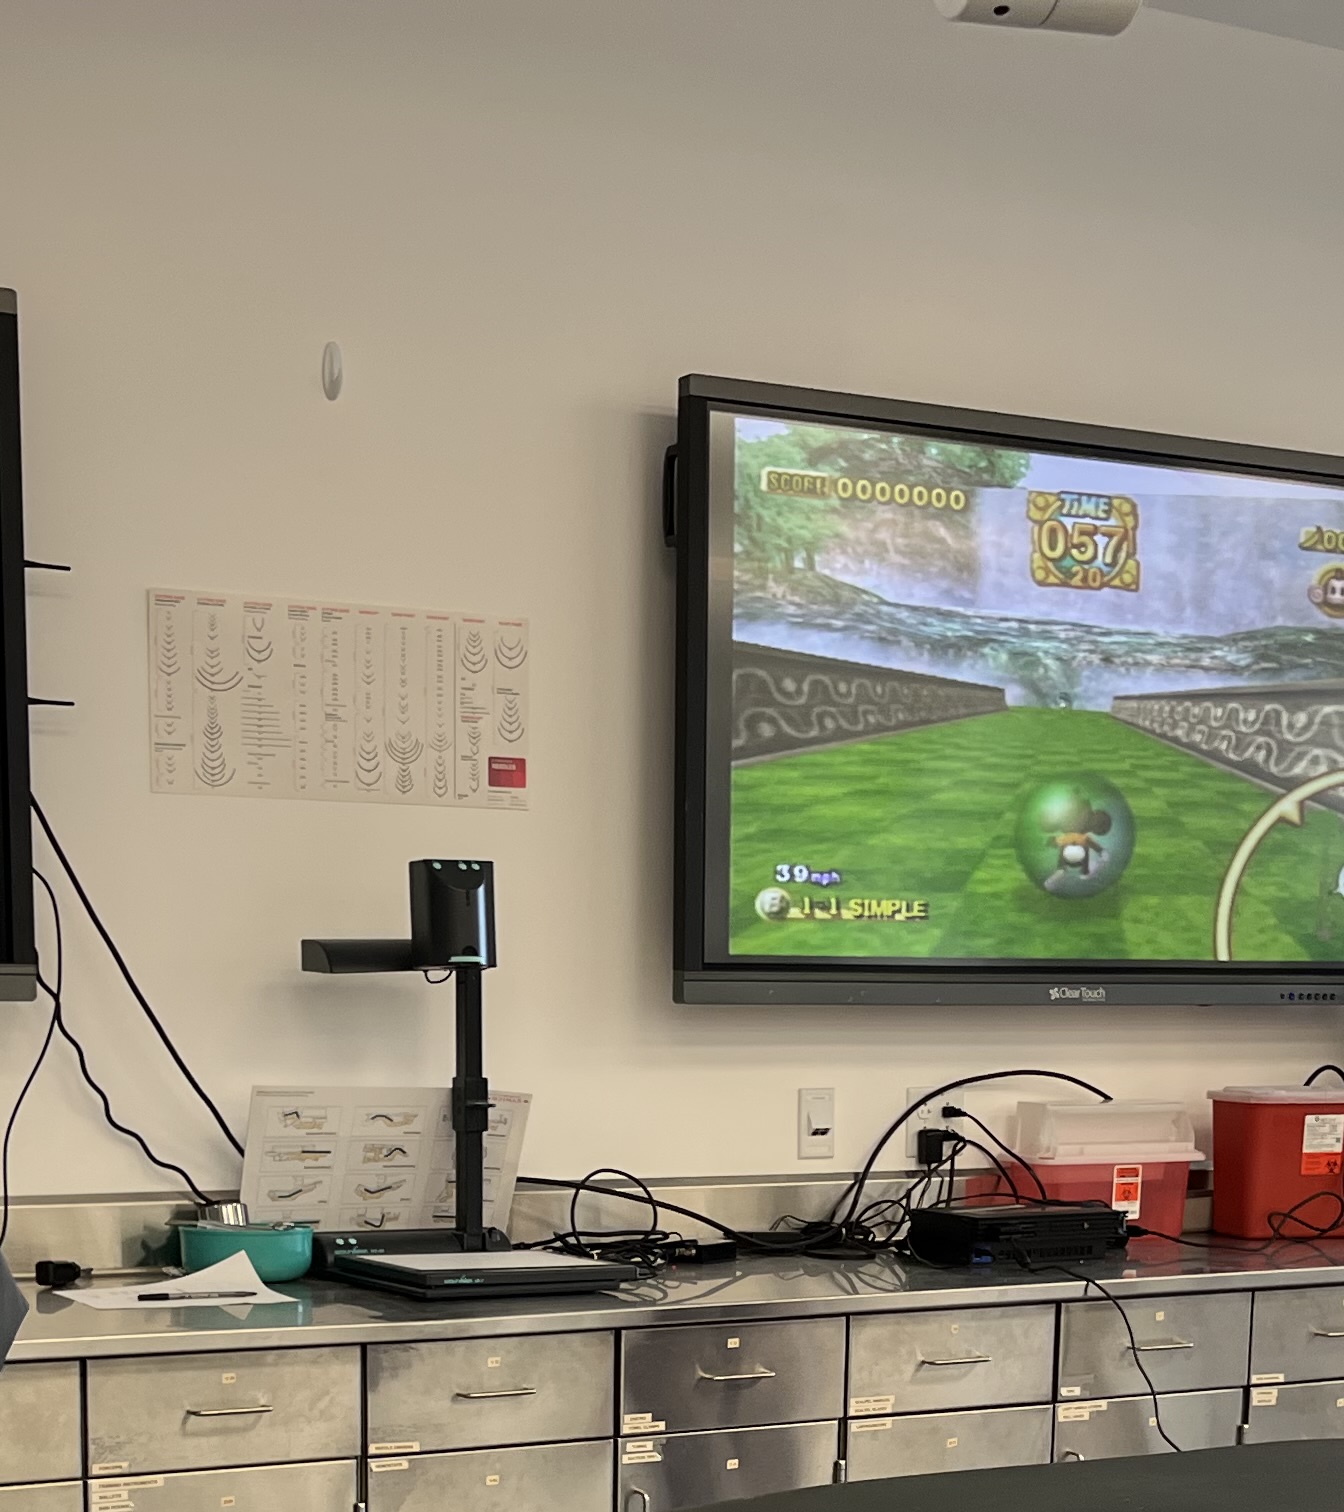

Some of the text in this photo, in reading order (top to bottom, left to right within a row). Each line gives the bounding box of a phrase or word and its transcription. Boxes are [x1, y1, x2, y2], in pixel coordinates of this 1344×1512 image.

[836, 477, 967, 511] 0000000
[1059, 491, 1111, 520] TIME
[1040, 519, 1126, 566] 057
[848, 898, 927, 918] SIMPLE
